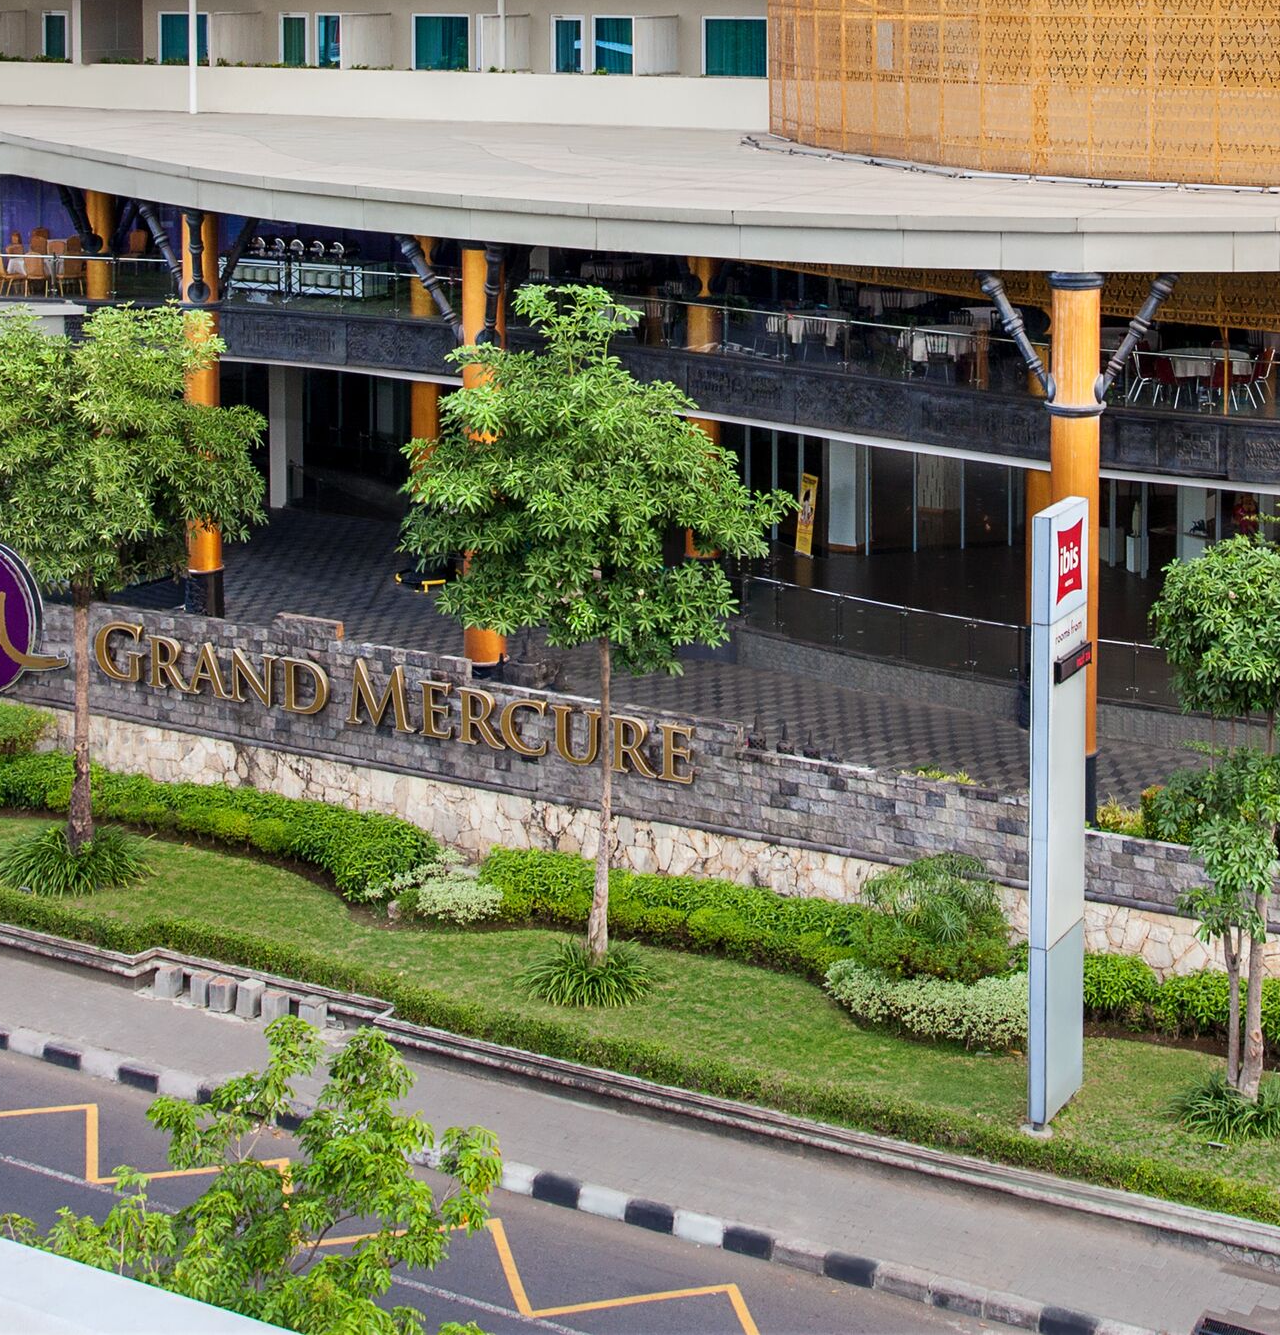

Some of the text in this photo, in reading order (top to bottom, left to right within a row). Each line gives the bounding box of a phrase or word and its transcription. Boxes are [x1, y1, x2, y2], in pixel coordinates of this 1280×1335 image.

[1060, 542, 1079, 577] ibis
[94, 621, 696, 785] GRAND MERCURE
